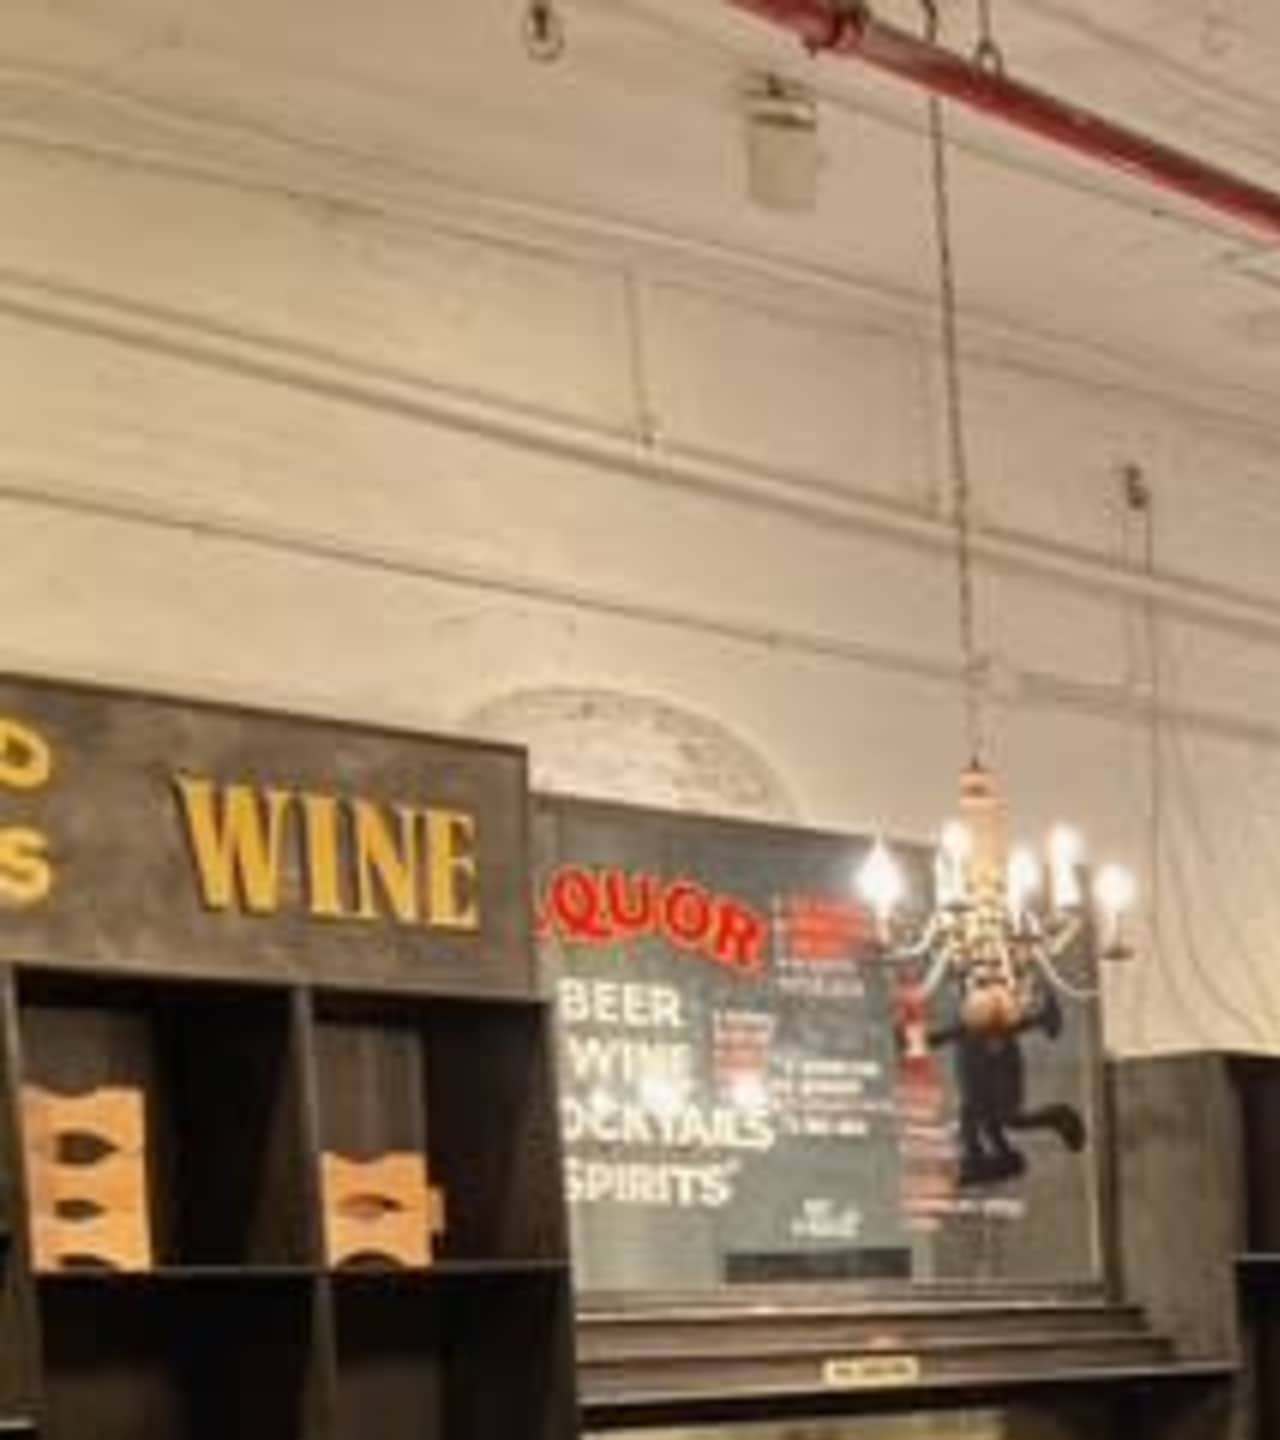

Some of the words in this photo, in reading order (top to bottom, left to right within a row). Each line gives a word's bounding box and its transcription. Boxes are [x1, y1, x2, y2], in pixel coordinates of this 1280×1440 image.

[174, 770, 480, 931] WINE
[540, 865, 769, 974] QUOR
[558, 976, 684, 1028] BEER
[565, 1156, 738, 1207] SPIRITS
